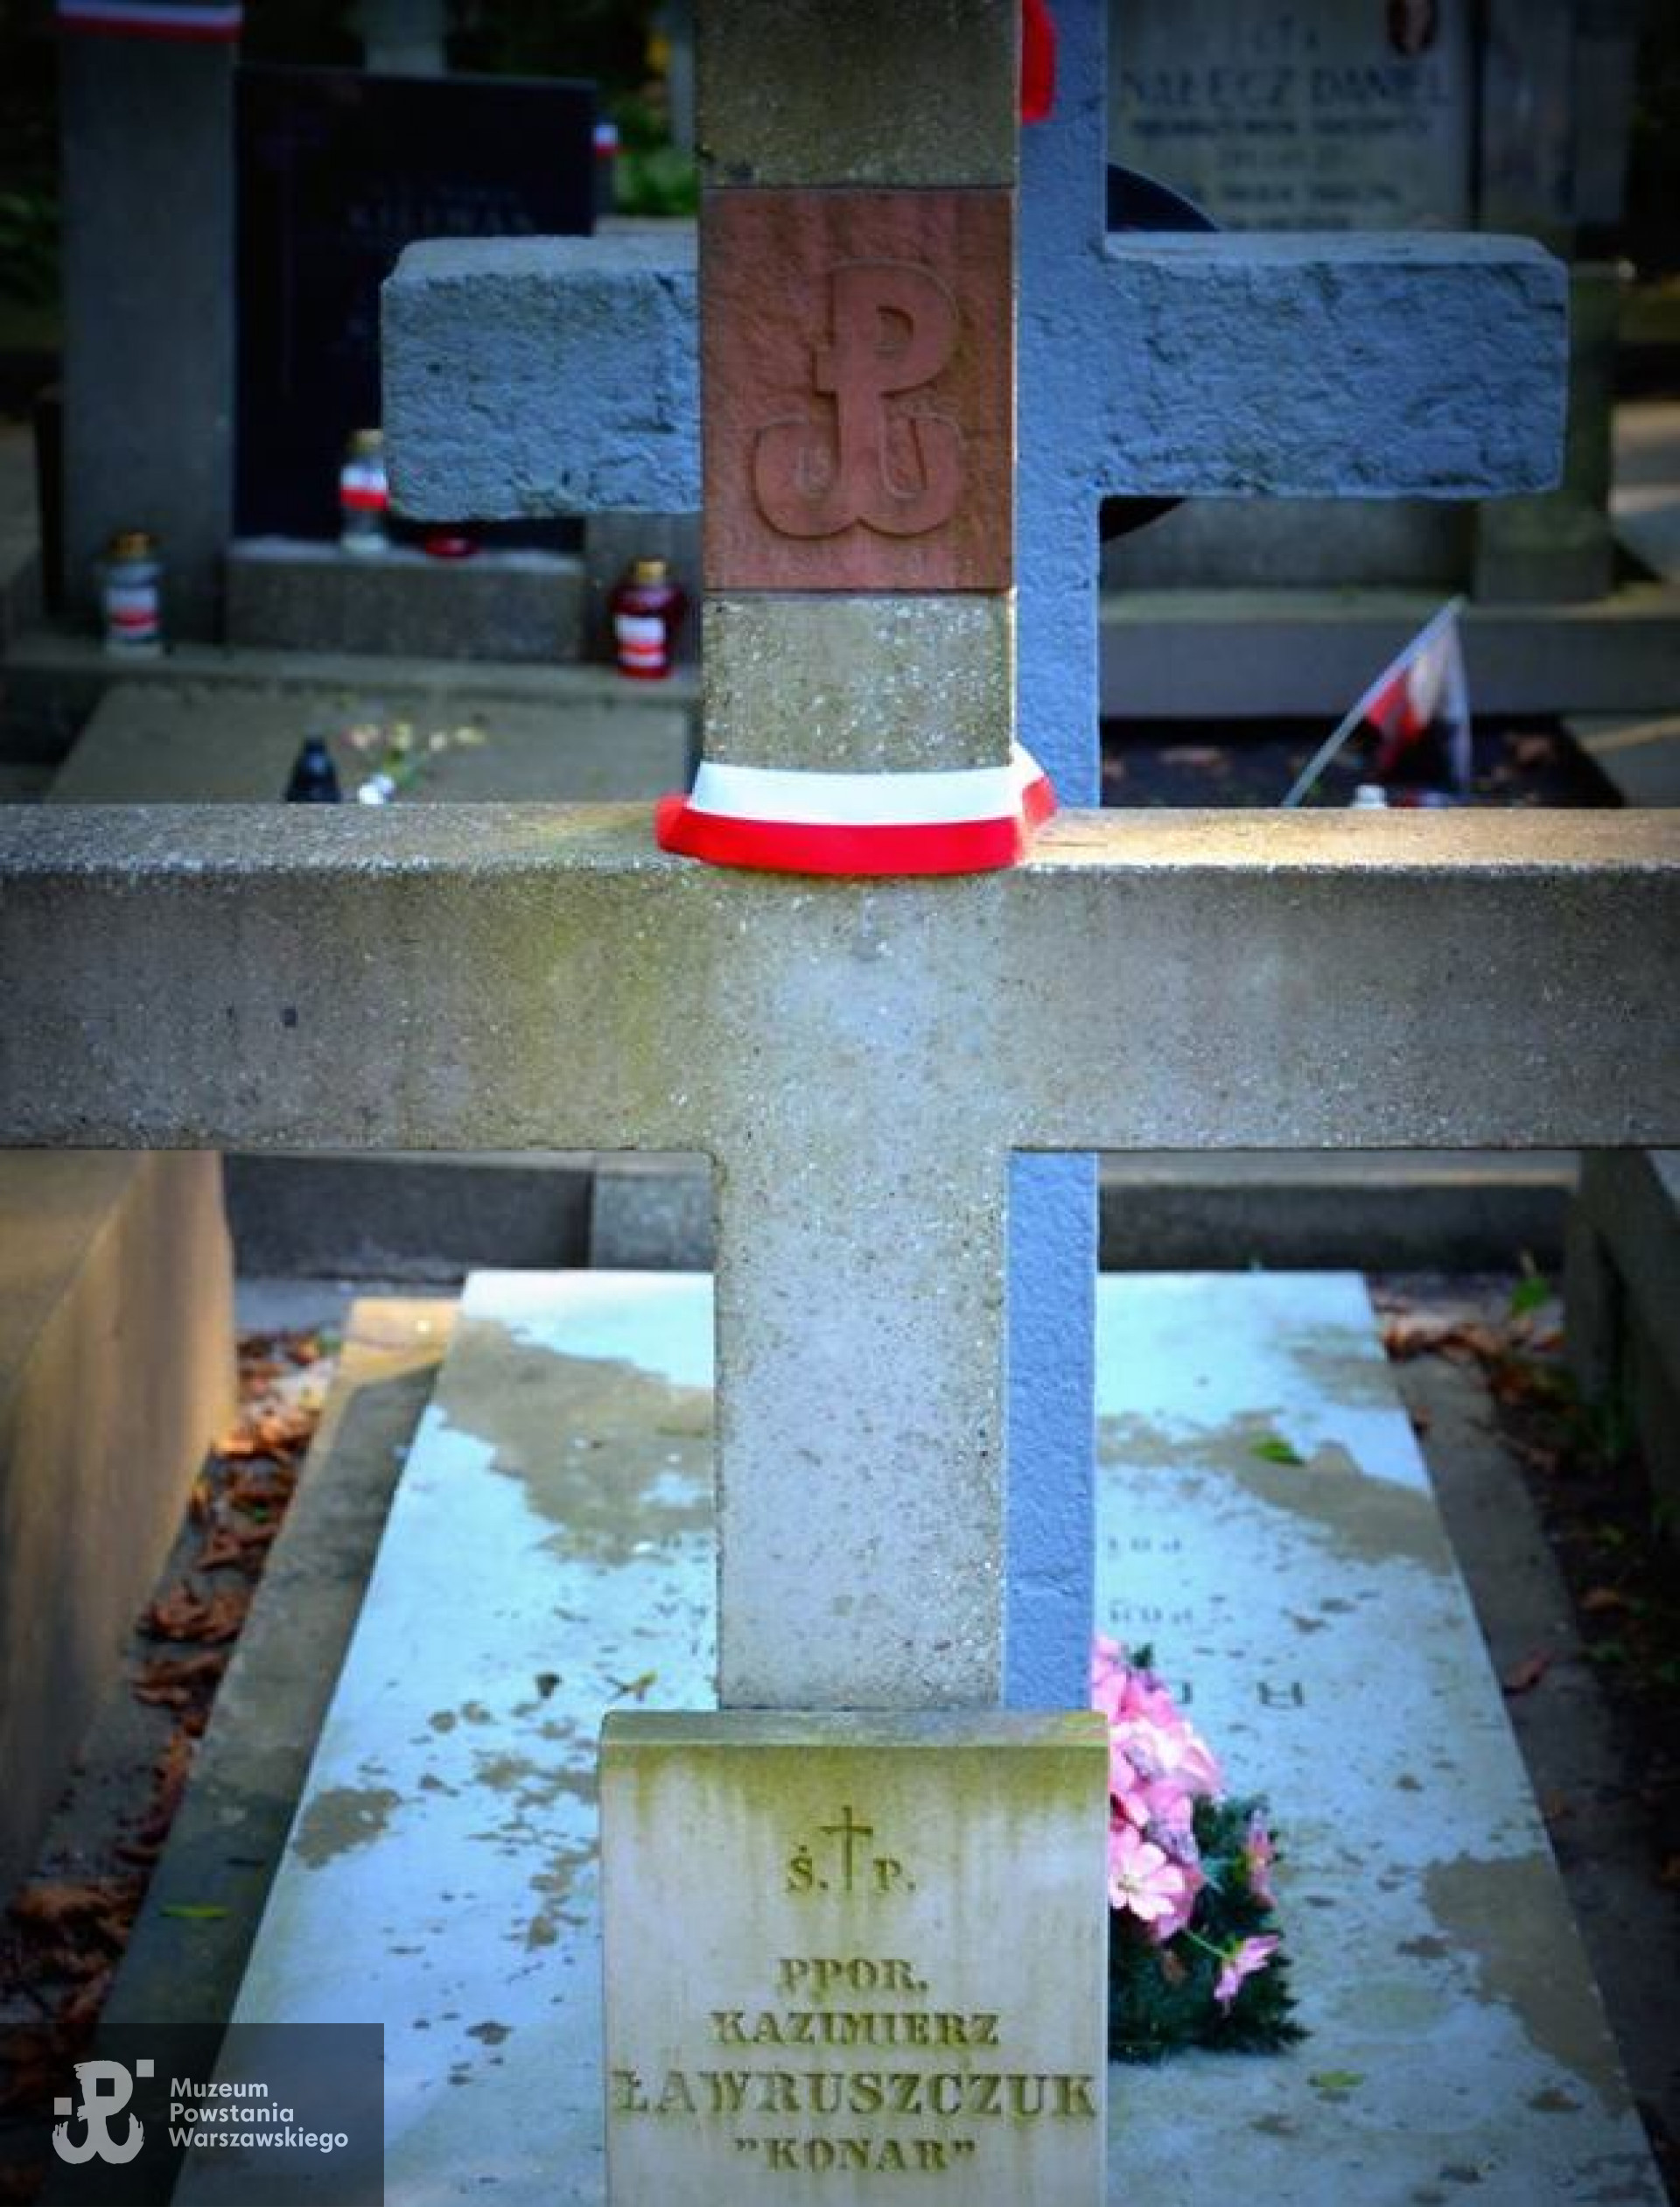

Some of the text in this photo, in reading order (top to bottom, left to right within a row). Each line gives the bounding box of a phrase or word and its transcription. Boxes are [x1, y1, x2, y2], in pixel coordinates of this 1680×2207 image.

[873, 1858, 916, 1891] P.
[778, 1958, 929, 1992] PPOR.
[710, 2010, 1000, 2045] KAZIMIERZ
[612, 2069, 1096, 2117] ŁAWRUSZCZUK
